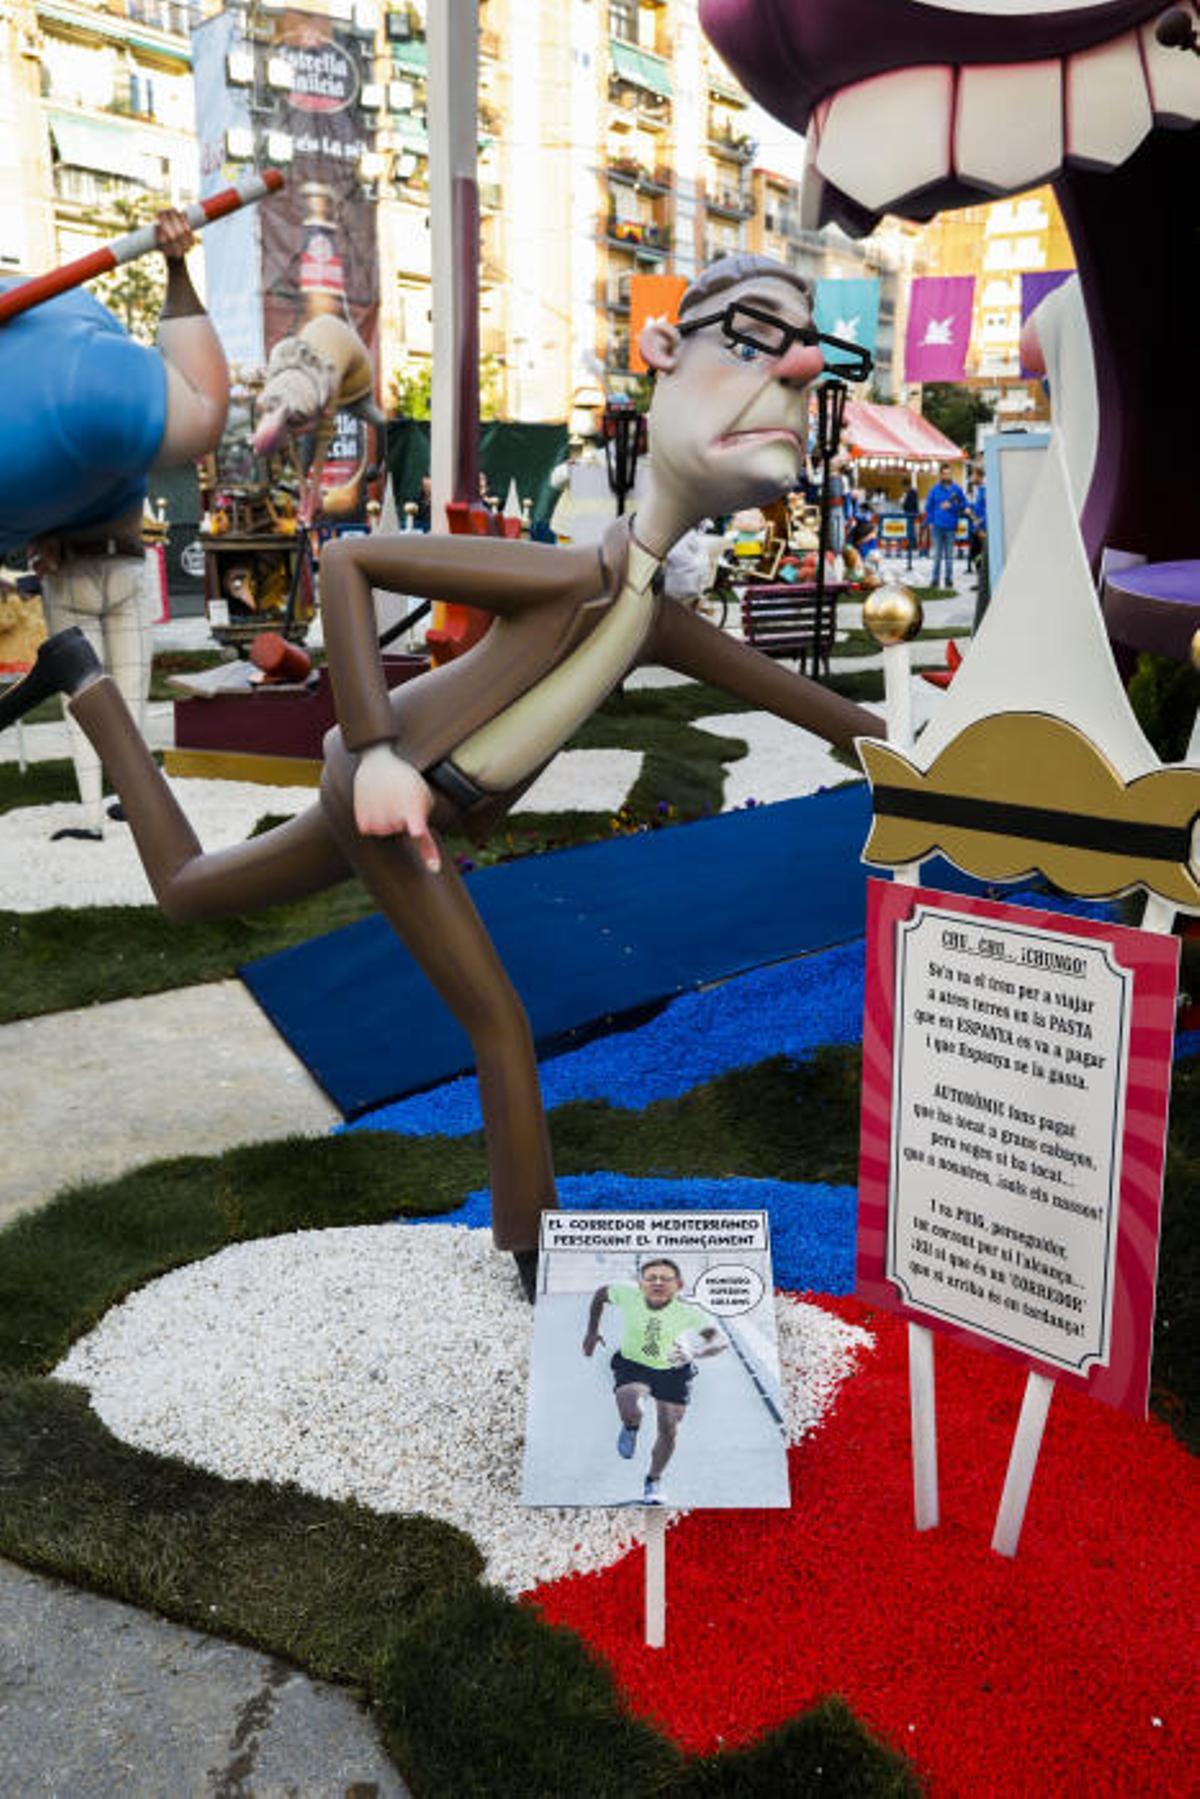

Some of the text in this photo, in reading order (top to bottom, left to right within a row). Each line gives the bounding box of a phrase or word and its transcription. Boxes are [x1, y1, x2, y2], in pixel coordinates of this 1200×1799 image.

[549, 1219, 563, 1231] EL
[569, 1219, 645, 1231] CORREDOR
[554, 1234, 754, 1249] PERSEGUINT EL FINANÇAMENT
